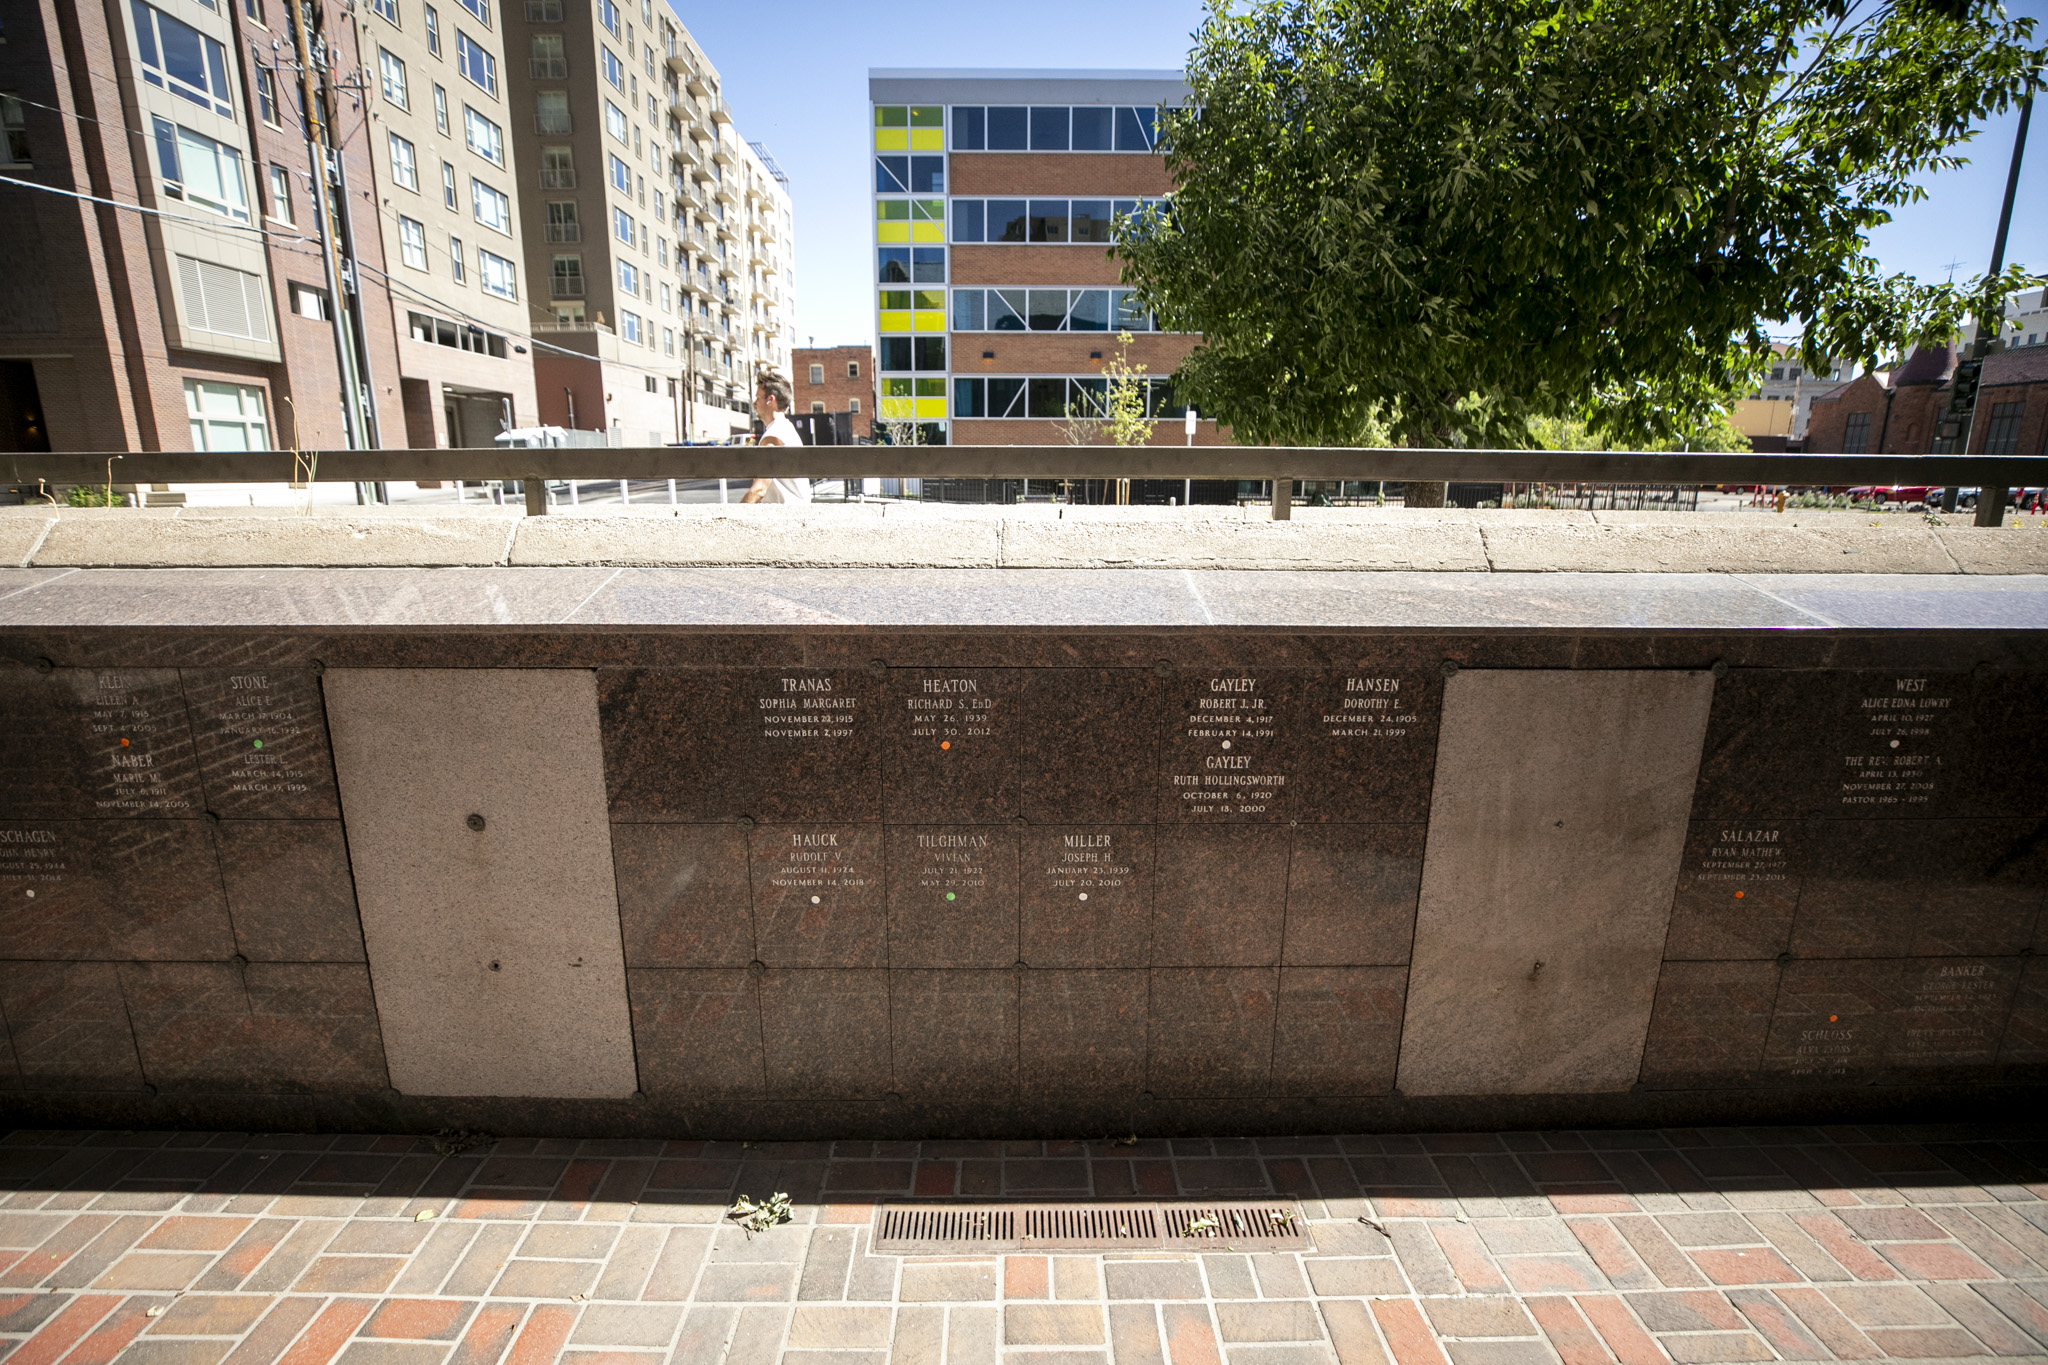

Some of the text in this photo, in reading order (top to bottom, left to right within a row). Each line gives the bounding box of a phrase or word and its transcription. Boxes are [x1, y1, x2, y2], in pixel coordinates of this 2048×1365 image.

[230, 676, 269, 689] STONE
[782, 678, 832, 692] TRANAS
[923, 679, 977, 693] HEATON
[1211, 679, 1256, 692] GAYLEY
[1346, 678, 1400, 692] HANSEN
[1896, 679, 1927, 692] WEST
[236, 696, 262, 706] ALICE
[760, 698, 856, 709] SOPHIA MARGARET
[908, 699, 953, 709] RICHARD
[1200, 699, 1237, 709] ROBERT
[1252, 699, 1267, 709] JR.
[1344, 698, 1389, 709] DOROTHY
[1861, 698, 1951, 708] ALICE EDNA LOWRY
[764, 715, 819, 723] NOVEMBER
[835, 715, 853, 723] 1915
[914, 714, 936, 722] MAY
[965, 714, 987, 722] 1939
[1190, 715, 1273, 723] DECEMBER 4, 1917
[1323, 715, 1417, 723] DECEMBER 24, 1905
[764, 729, 819, 737] NOVEMBER
[833, 729, 853, 737] 1997
[912, 728, 937, 736] JULY
[967, 728, 991, 736] 2012
[1188, 729, 1273, 737] FEBRUARY 14, 1991
[111, 754, 155, 767] NABER
[244, 754, 288, 764] LESTER L.
[1206, 756, 1252, 769] GAYLEY
[1845, 756, 1864, 766] THE
[1893, 756, 1930, 766] ROBERT
[1174, 776, 1285, 785] RUTH HOLLINGSWORTH
[1842, 783, 1892, 791] NOVEMBER
[1910, 783, 1934, 791] 2008
[1183, 792, 1229, 800] OCTOBER
[1251, 792, 1272, 800] 1920
[1842, 796, 1875, 804] PASTOR
[0, 830, 56, 843] SCHAGEN
[793, 834, 838, 846] HAUCK
[917, 835, 987, 847] TILGHMAN
[1064, 835, 1111, 847] MILLER
[1720, 830, 1779, 842] SALAZAR
[0, 848, 19, 857] OHN
[790, 852, 828, 862] RUDOLF
[934, 853, 971, 862] VIVIAN
[1062, 853, 1114, 862] JOSEPH H.
[1711, 848, 1783, 857] RYAN MATHEW
[1702, 861, 1751, 869] SEPTEMBER
[1046, 867, 1088, 875] JANUARY
[1109, 867, 1130, 875] 1939
[1940, 965, 1985, 977] BANKER
[1801, 1030, 1853, 1041] SCHLOSS
